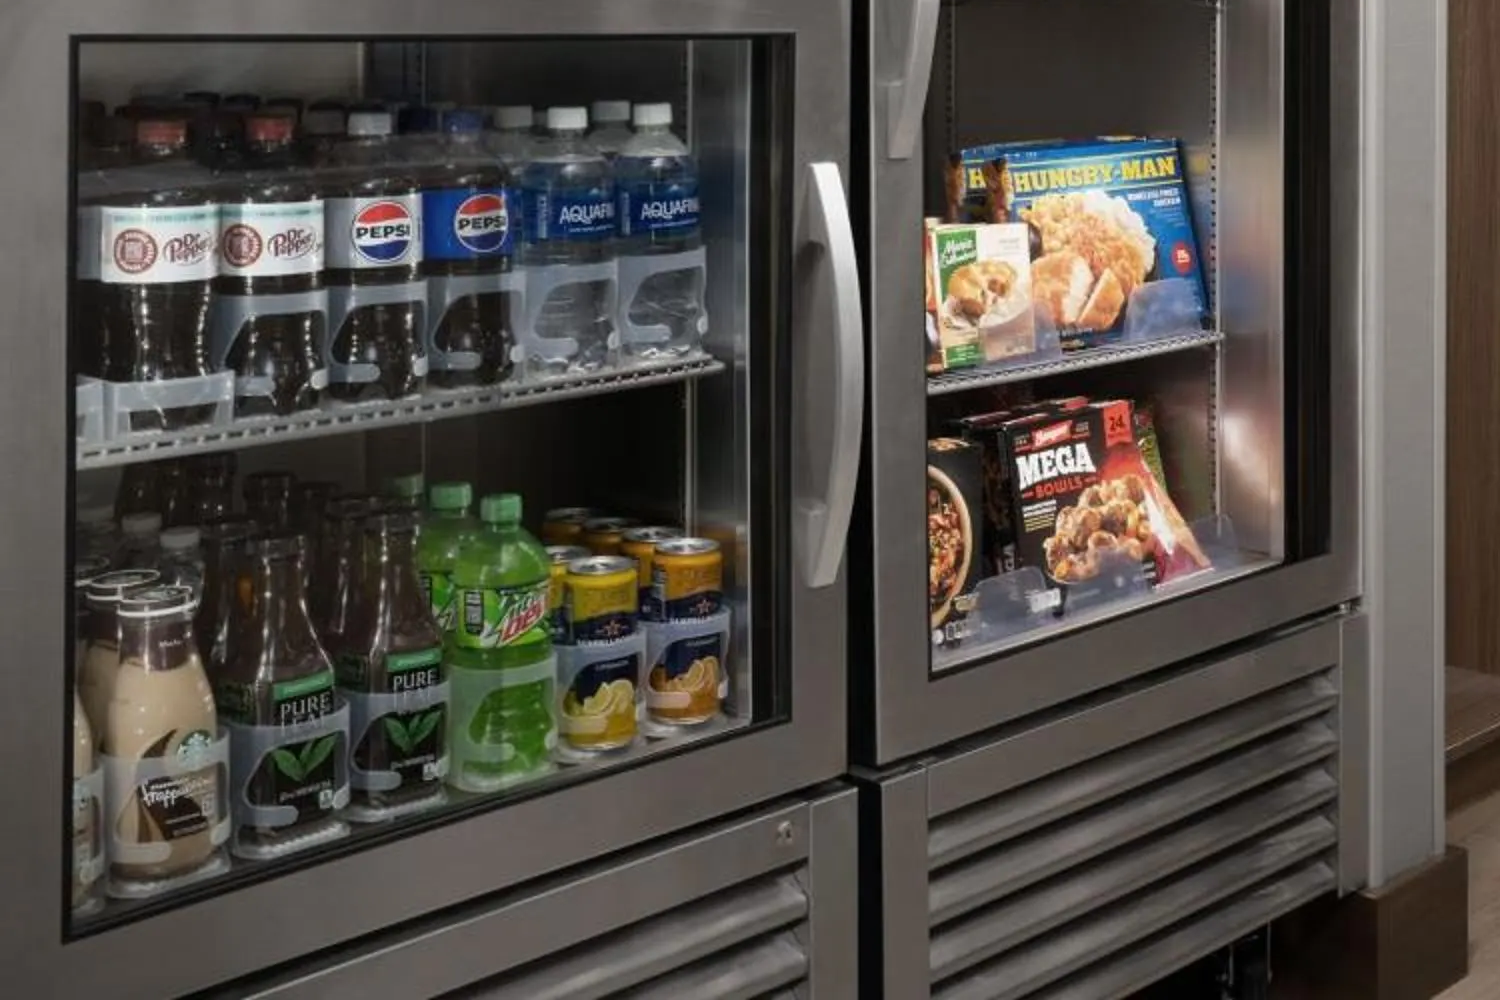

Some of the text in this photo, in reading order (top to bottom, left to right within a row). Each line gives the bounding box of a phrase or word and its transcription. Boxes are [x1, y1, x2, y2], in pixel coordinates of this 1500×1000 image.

[1013, 154, 1178, 194] HUNGRY-MAN
[355, 223, 412, 239] PEPSI
[458, 215, 508, 231] PEPSI
[1015, 441, 1097, 491] MEGA
[1034, 475, 1083, 499] BOWLS
[393, 670, 434, 692] PURE
[280, 692, 331, 716] PURE
